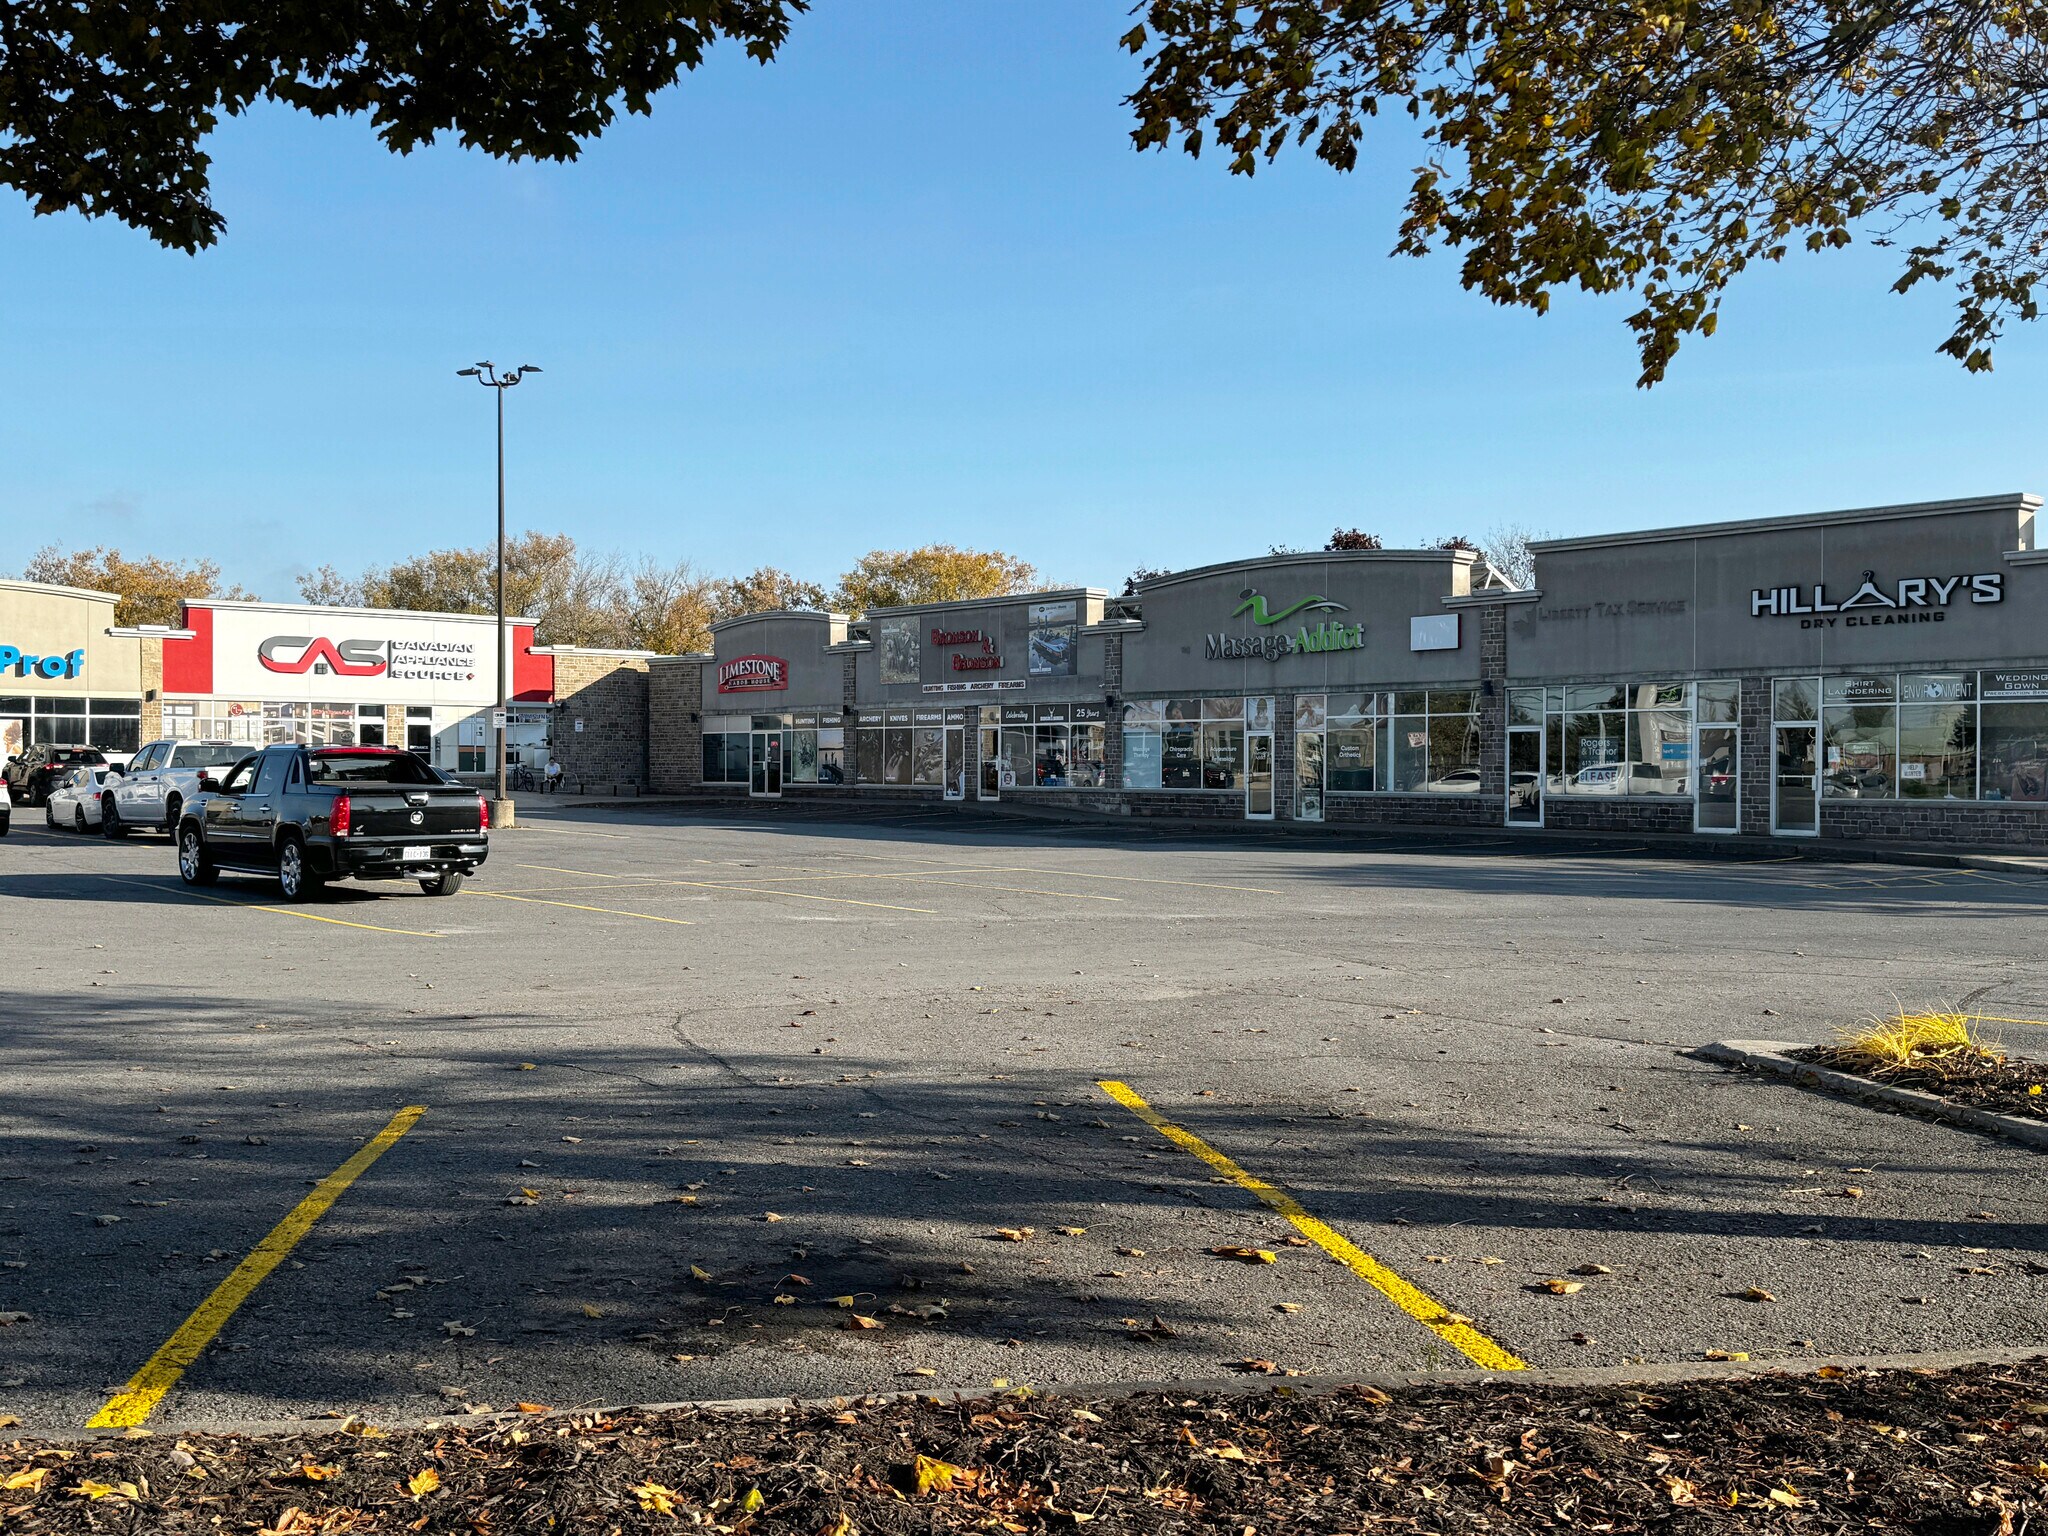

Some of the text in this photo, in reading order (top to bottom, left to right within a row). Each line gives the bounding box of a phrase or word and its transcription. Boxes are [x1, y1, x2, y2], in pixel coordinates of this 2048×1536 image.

[1751, 570, 2004, 617] HILLARY'S
[1800, 612, 1945, 630] DRY CLEANING
[392, 641, 476, 653] CANADIAN
[982, 636, 995, 653] &
[1204, 622, 1364, 662] Massage Addict
[0, 644, 85, 678] Prof
[258, 636, 387, 676] CAS
[392, 654, 476, 667] APPLIANCE
[391, 669, 466, 681] SOURCE
[719, 660, 780, 684] LIMESTONE
[1995, 674, 2048, 682] WEDDING
[1845, 680, 1875, 688] SHIRT
[2004, 682, 2039, 690] GOWN
[1828, 687, 1892, 695] LAUNDERING
[889, 714, 908, 722] KNIVES
[916, 713, 942, 721] FIREARMS
[946, 713, 964, 721] AMMO
[1005, 710, 1029, 721] Celebrating
[1076, 708, 1100, 718] 25 Years
[822, 716, 841, 724] FISHING
[1581, 738, 1611, 748] Rogers
[1588, 747, 1617, 755] Tranor
